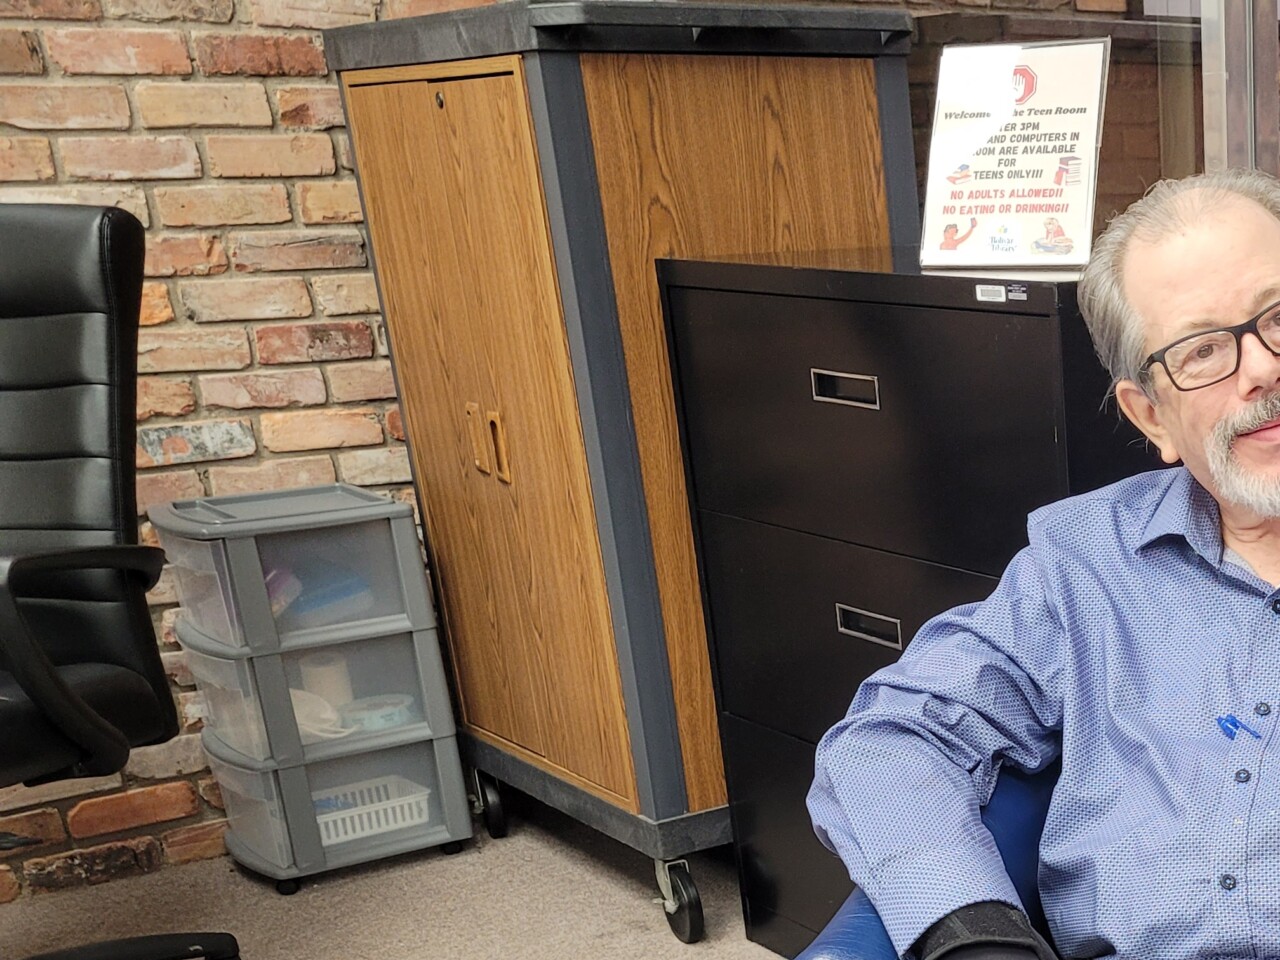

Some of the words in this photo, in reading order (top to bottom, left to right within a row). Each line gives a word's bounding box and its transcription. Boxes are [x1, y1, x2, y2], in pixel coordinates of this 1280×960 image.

[1027, 108, 1053, 116] Teen
[1055, 106, 1087, 115] Room
[1020, 122, 1040, 131] 3PM
[1010, 133, 1067, 143] COMPUTERS
[1070, 132, 1080, 141] IN
[999, 146, 1019, 155] ARE
[1022, 144, 1076, 154] AVAILABLE
[997, 158, 1016, 167] FOR
[973, 170, 1004, 180] TEENS
[950, 191, 963, 200] NO
[967, 190, 1005, 199] ADULTS
[942, 205, 956, 215] NO
[959, 205, 995, 214] EATING
[998, 204, 1012, 213] OR
